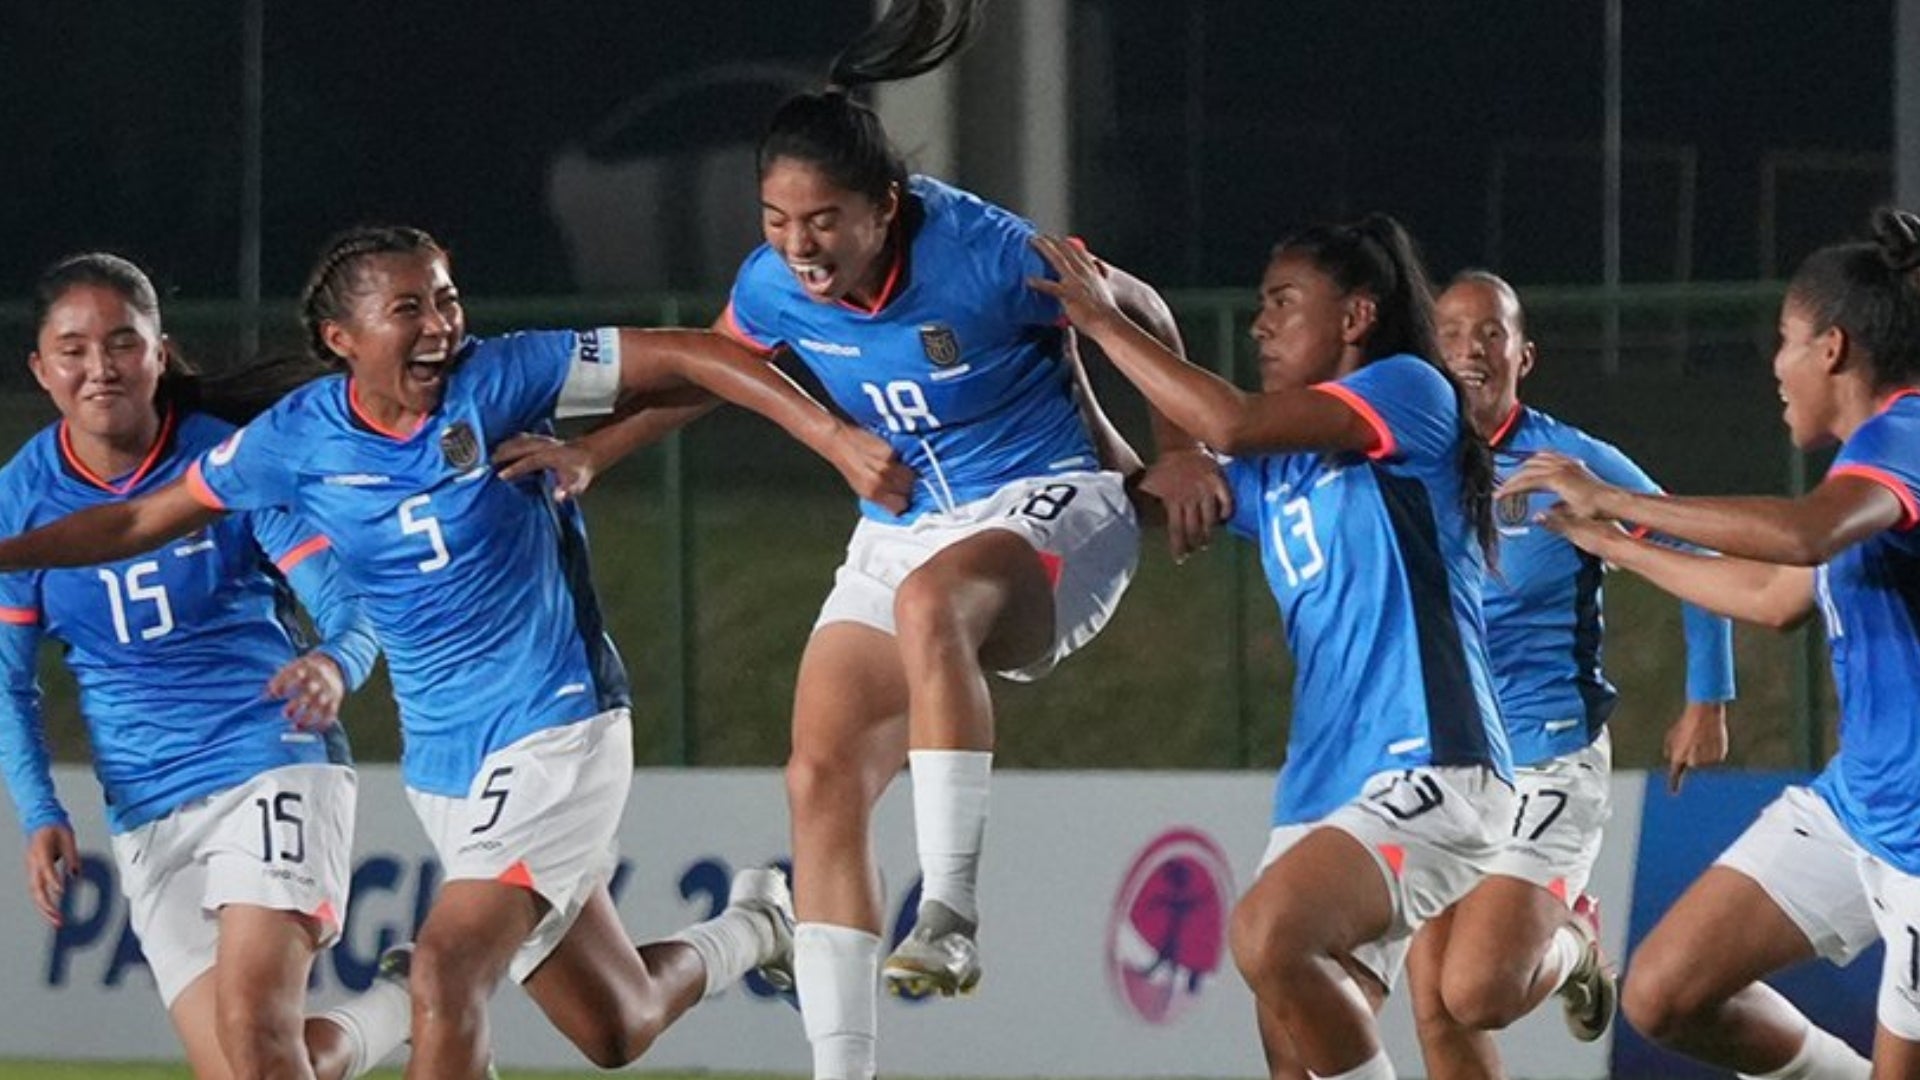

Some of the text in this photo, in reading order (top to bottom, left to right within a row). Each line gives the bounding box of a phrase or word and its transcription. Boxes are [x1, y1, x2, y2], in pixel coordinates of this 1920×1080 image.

[861, 380, 941, 433] 18
[399, 493, 450, 573] 5
[1272, 496, 1324, 587] 13
[97, 560, 174, 644] 15
[256, 791, 305, 863] 15
[470, 765, 514, 835] 5
[1512, 788, 1568, 841] 17
